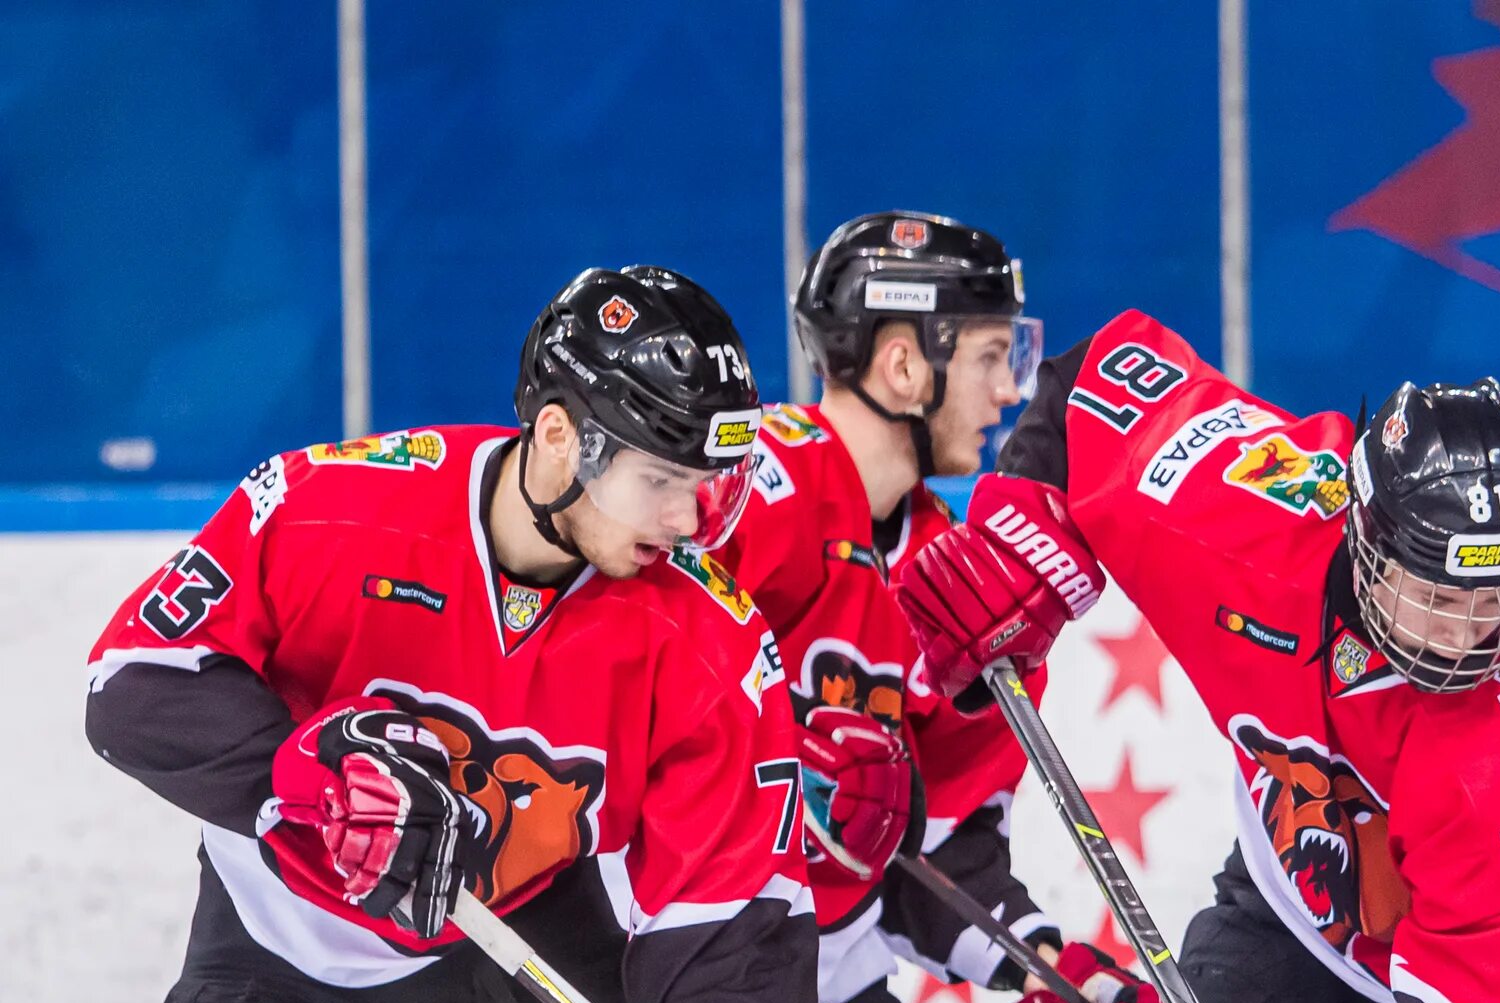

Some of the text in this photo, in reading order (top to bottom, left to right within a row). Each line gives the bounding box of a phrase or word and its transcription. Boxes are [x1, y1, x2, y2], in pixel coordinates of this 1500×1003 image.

[706, 343, 745, 383] 73
[1067, 341, 1188, 436] 81
[393, 585, 444, 610] mastercard
[1245, 622, 1297, 651] mastercard
